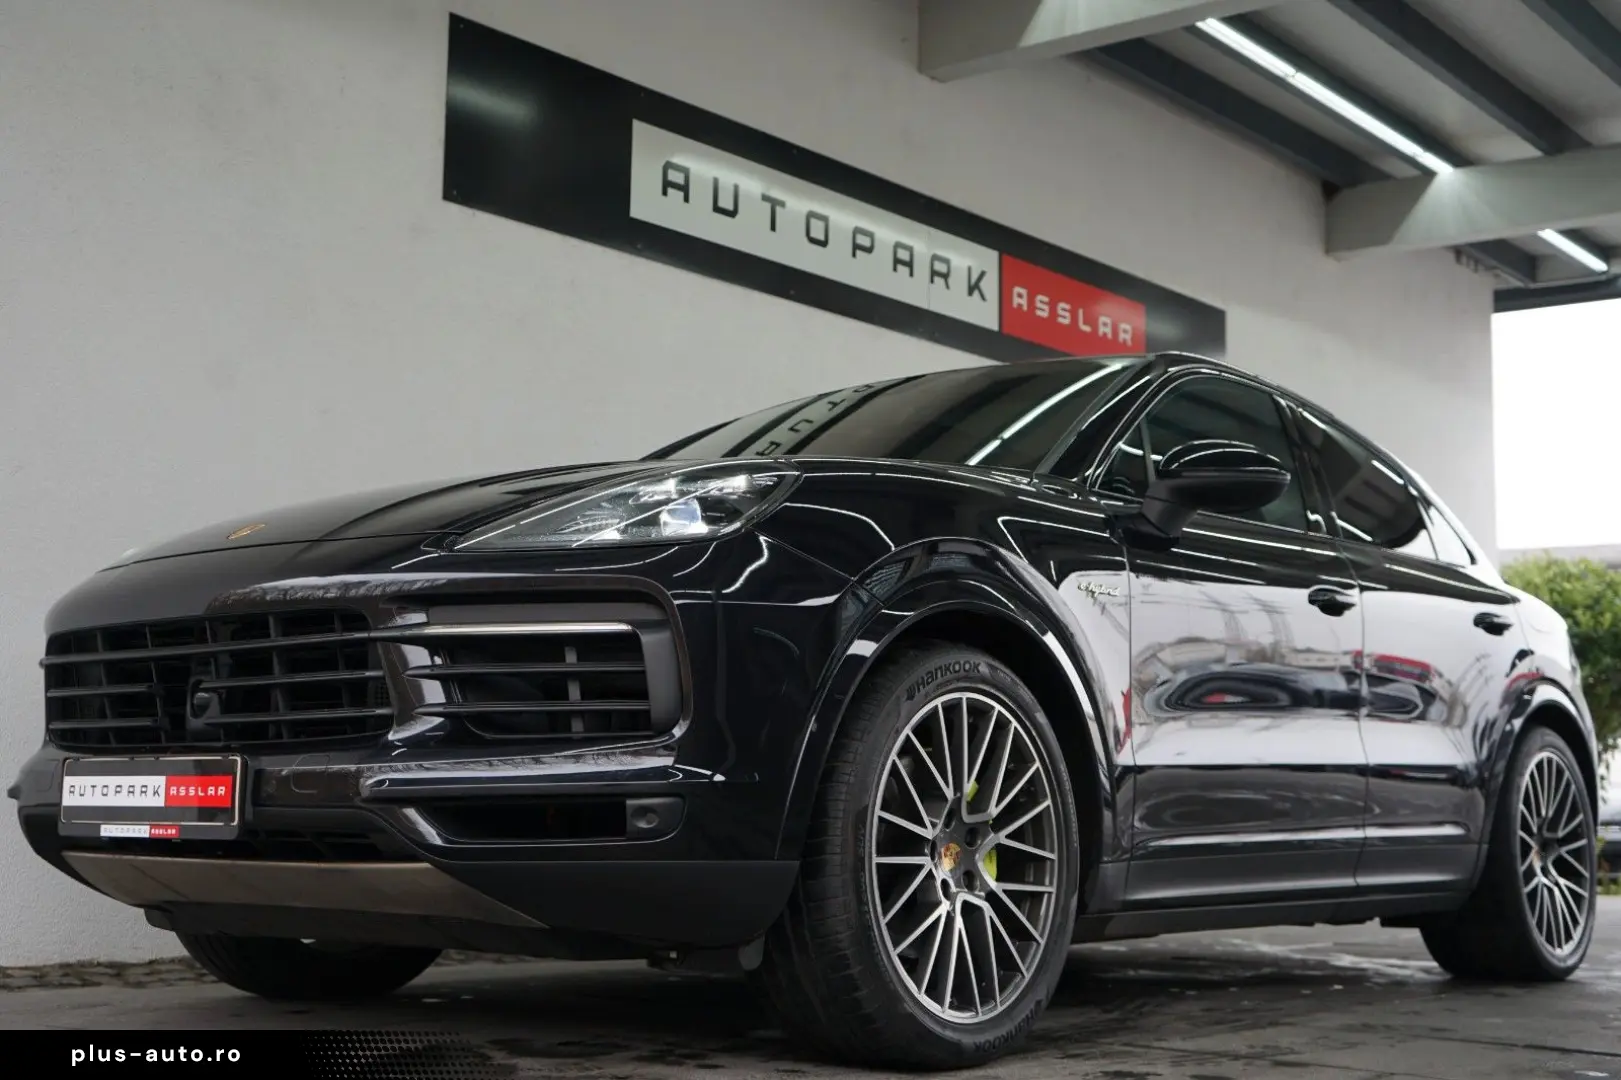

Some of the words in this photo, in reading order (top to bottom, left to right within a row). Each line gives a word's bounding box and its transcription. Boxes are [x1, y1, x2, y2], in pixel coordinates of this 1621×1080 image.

[662, 159, 987, 302] AUTOPARK
[1012, 285, 1133, 346] ASSLAR
[68, 784, 161, 798] AUTOPARK
[169, 785, 226, 797] ASSLAR
[103, 827, 148, 836] AUTOPARK
